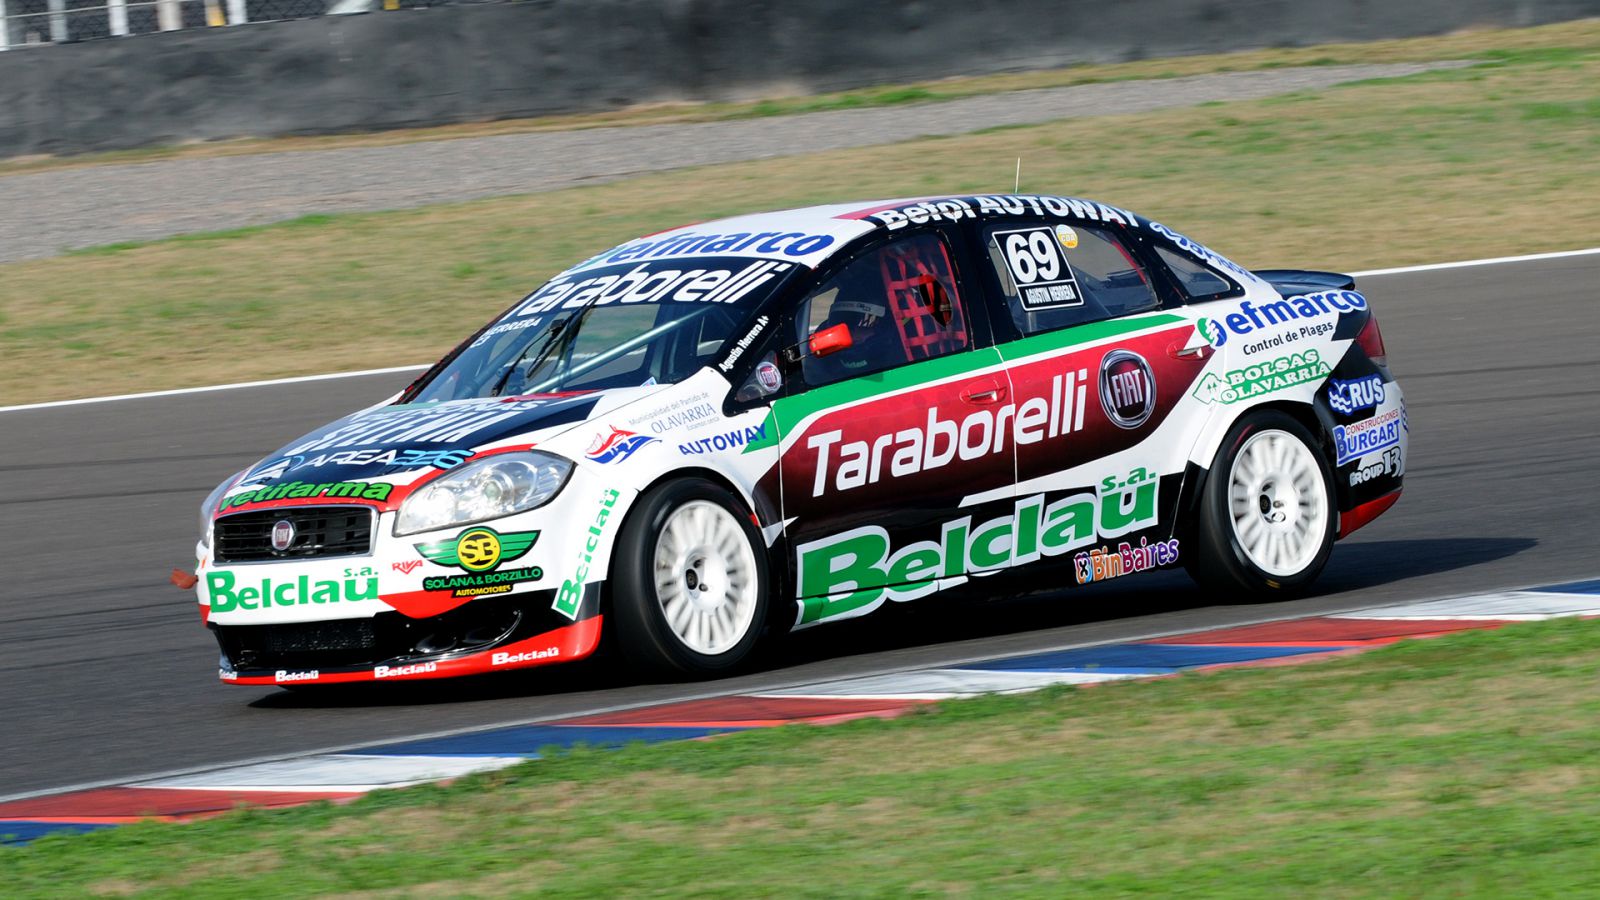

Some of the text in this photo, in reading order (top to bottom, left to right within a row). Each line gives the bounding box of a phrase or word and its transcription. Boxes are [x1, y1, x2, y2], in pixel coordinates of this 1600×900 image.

[974, 195, 1139, 228] AUTOWAY
[1006, 231, 1060, 283] 69
[500, 259, 793, 322] Taraborelli
[1025, 284, 1077, 304] AGUSTIN HERRERA
[737, 323, 764, 349] Herrera
[1243, 321, 1334, 356] Control de Plagas
[1221, 362, 1331, 402] OLAVARRIA
[1228, 350, 1318, 383] BOLSAS
[1111, 369, 1144, 409] FIAT
[1348, 378, 1385, 408] RUS
[651, 402, 717, 433] OLAVARRIA
[807, 368, 1087, 497] Taraborelli
[1346, 408, 1399, 436] CONSTRUCCIONES
[284, 410, 525, 457] SELENIA
[678, 424, 767, 455] AUTOWAY
[1333, 419, 1400, 460] BURGART
[1101, 467, 1156, 493] s.a.
[218, 481, 392, 512] vetifarma
[461, 539, 496, 562] SB
[802, 482, 1156, 625] Belclau
[343, 566, 379, 578] s.a.
[392, 560, 423, 575] RIVA
[425, 567, 542, 589] SOLANA & BORZILLO
[455, 584, 511, 597] AUTOMOTORES
